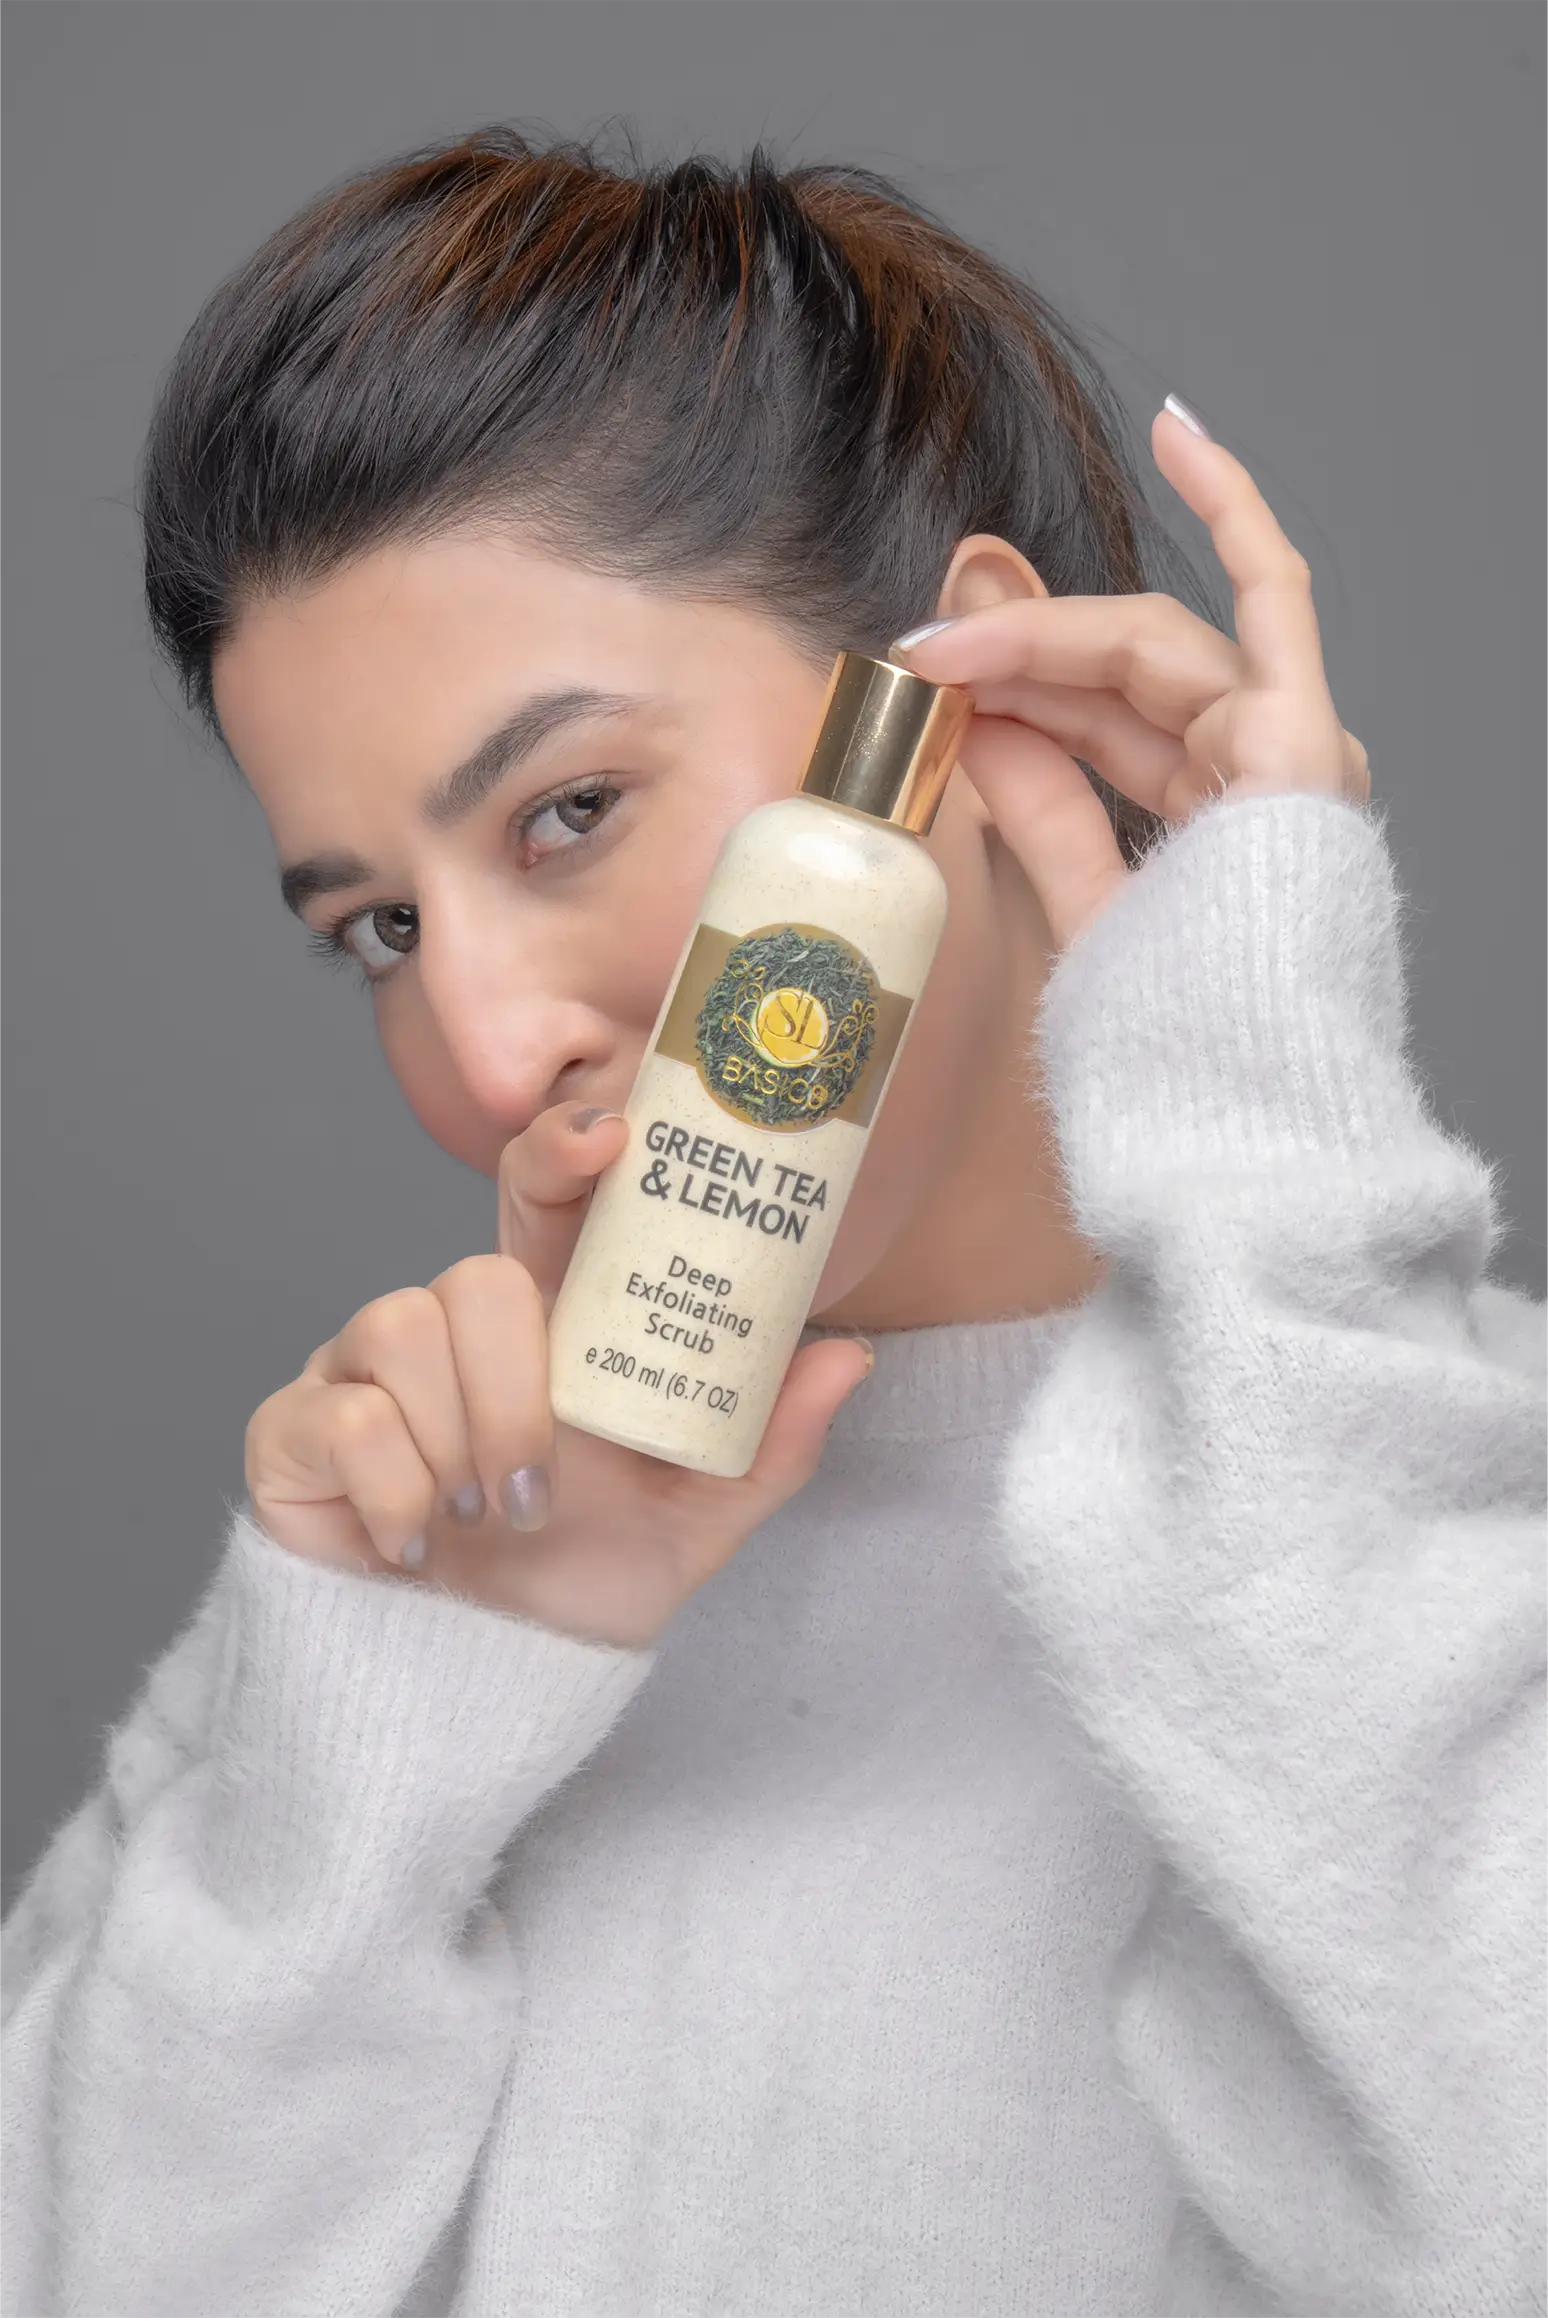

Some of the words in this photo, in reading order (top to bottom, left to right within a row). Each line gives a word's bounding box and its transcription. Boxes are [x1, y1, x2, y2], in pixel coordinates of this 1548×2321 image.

[645, 1121, 764, 1188] GREEN
[774, 1163, 829, 1211] TEA
[640, 1158, 672, 1201] &
[678, 1174, 811, 1244] LEMON
[625, 1273, 752, 1337] Exfoliating
[669, 1255, 733, 1297] Deep
[644, 1312, 715, 1353] Scrub
[599, 1347, 637, 1379] 200
[638, 1366, 665, 1388] ml
[666, 1373, 706, 1402] (6.7
[708, 1386, 740, 1419] OZ)
